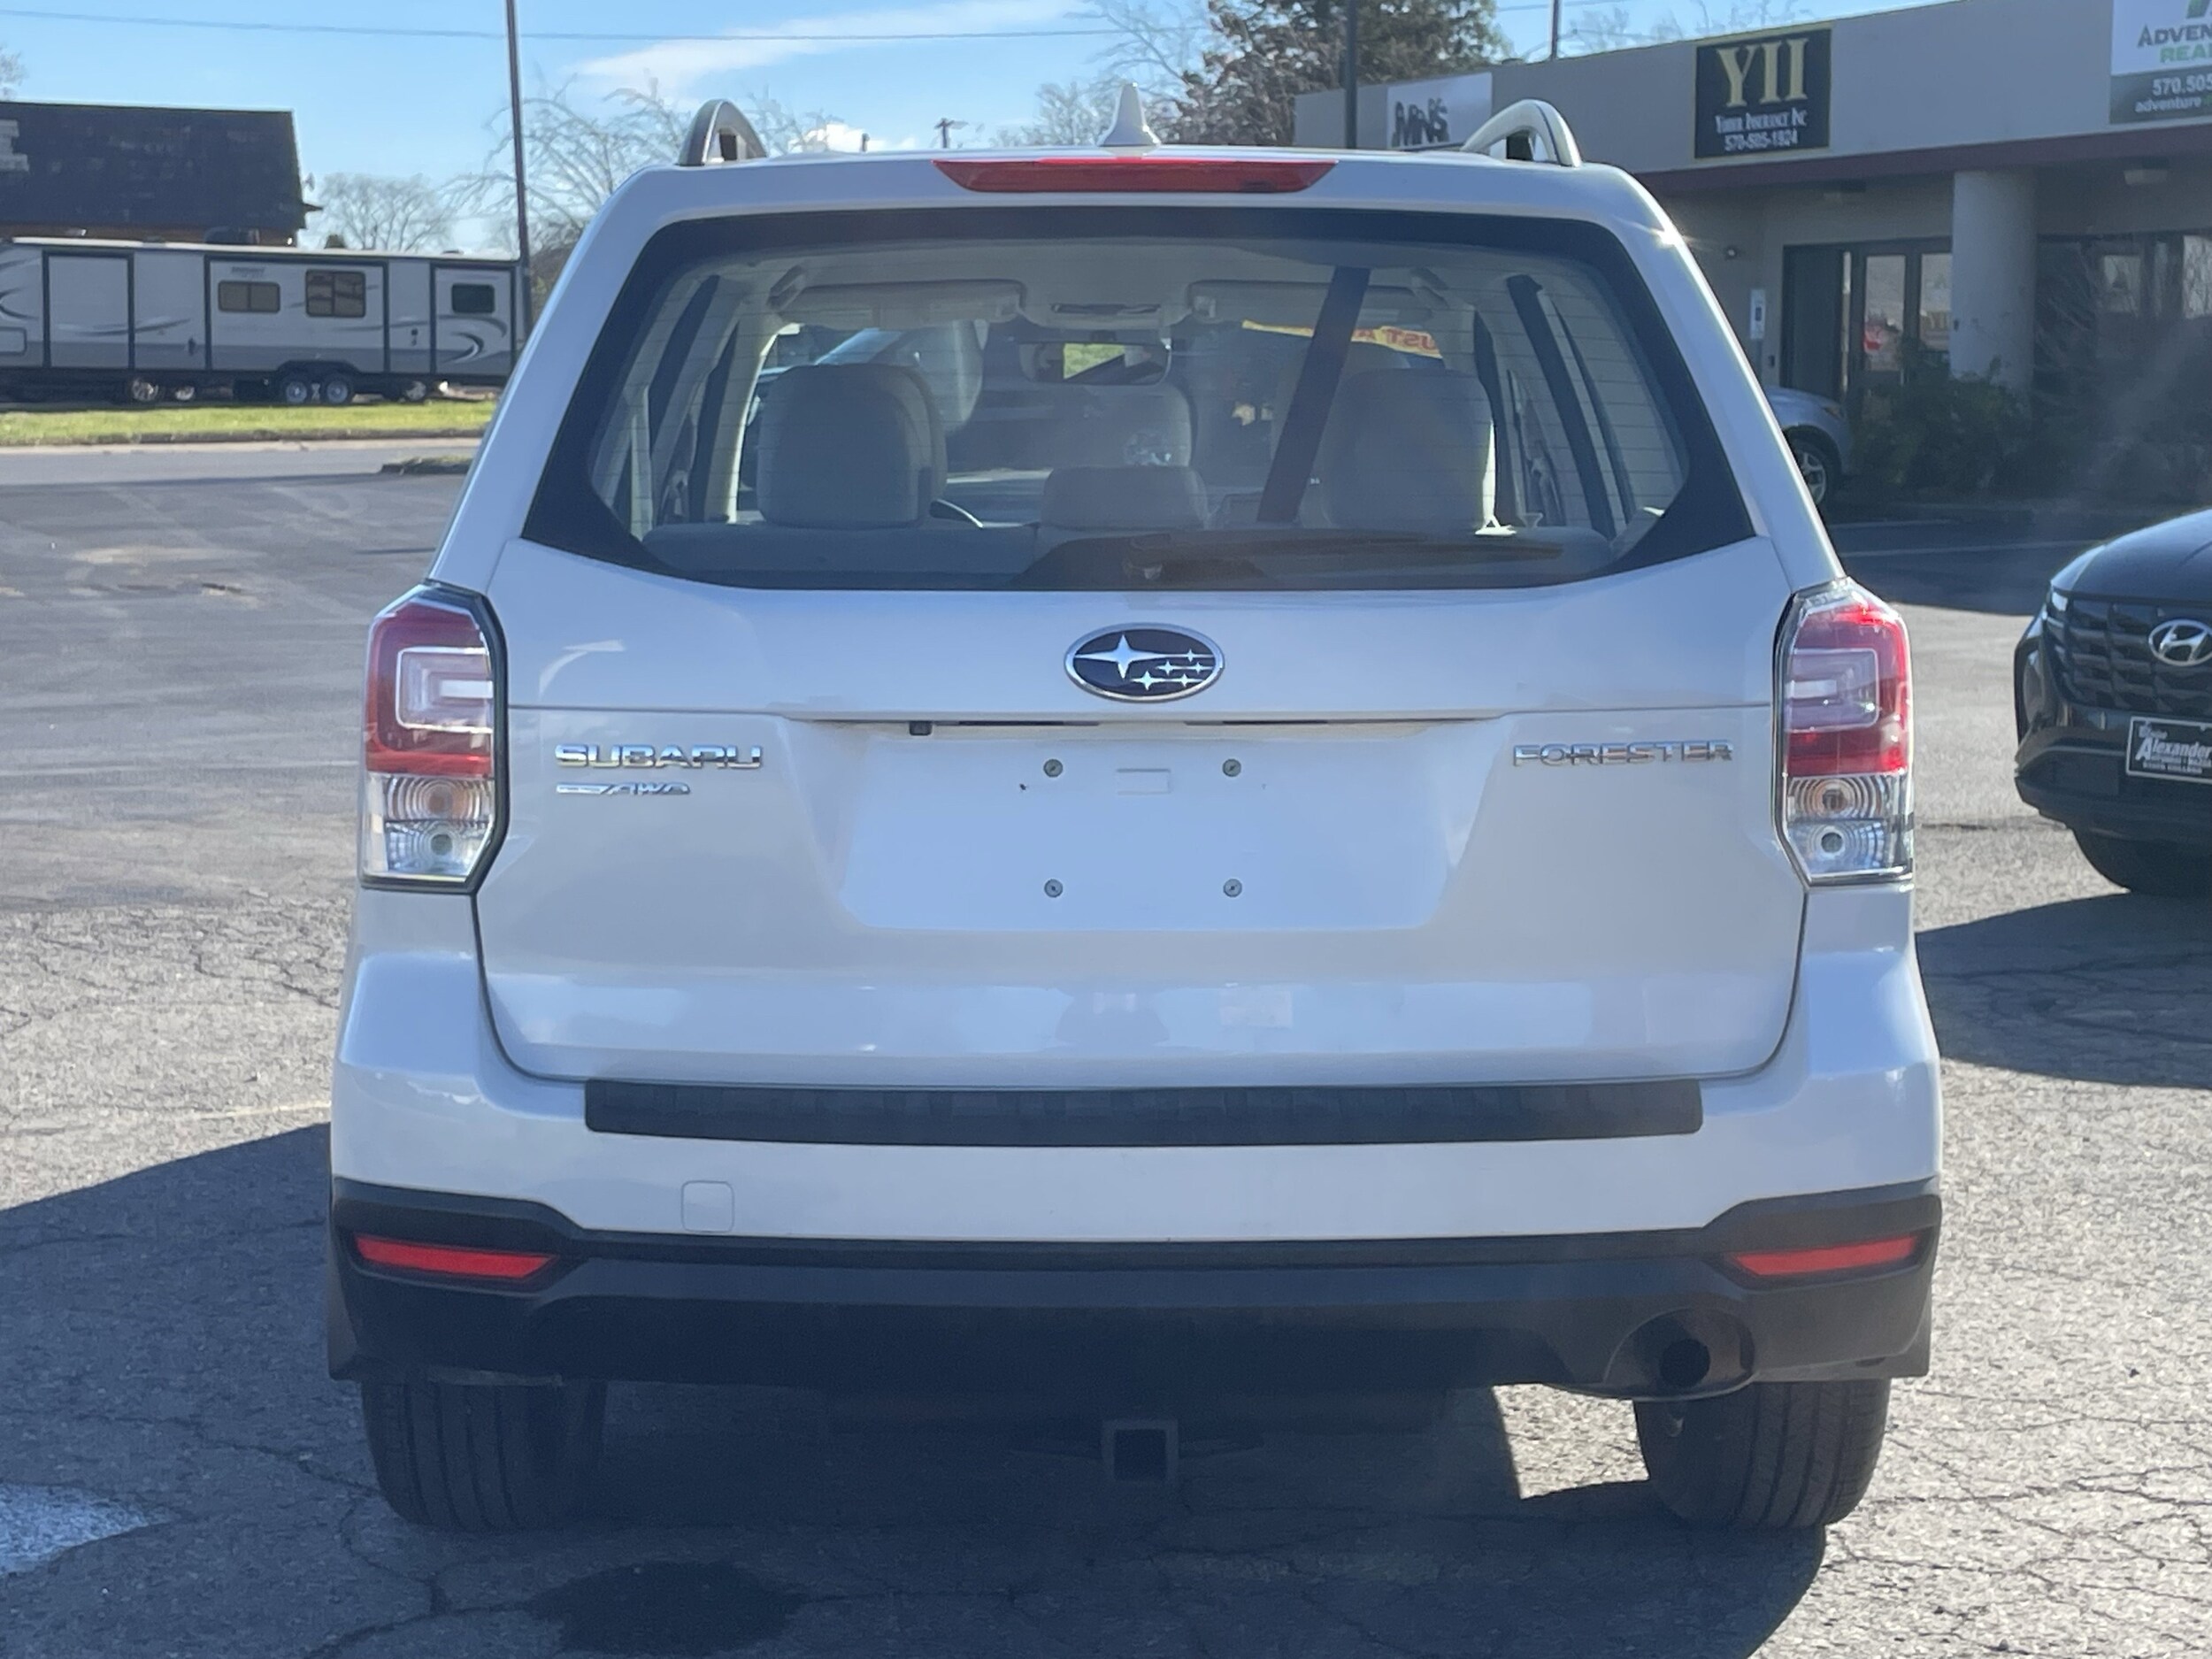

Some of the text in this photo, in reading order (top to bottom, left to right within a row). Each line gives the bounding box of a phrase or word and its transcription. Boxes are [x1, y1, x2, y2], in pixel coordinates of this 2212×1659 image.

[2160, 42, 2212, 63] REA
[1717, 37, 1808, 107] YII
[554, 744, 762, 769] SUBARU
[1513, 740, 1734, 767] FORESTER
